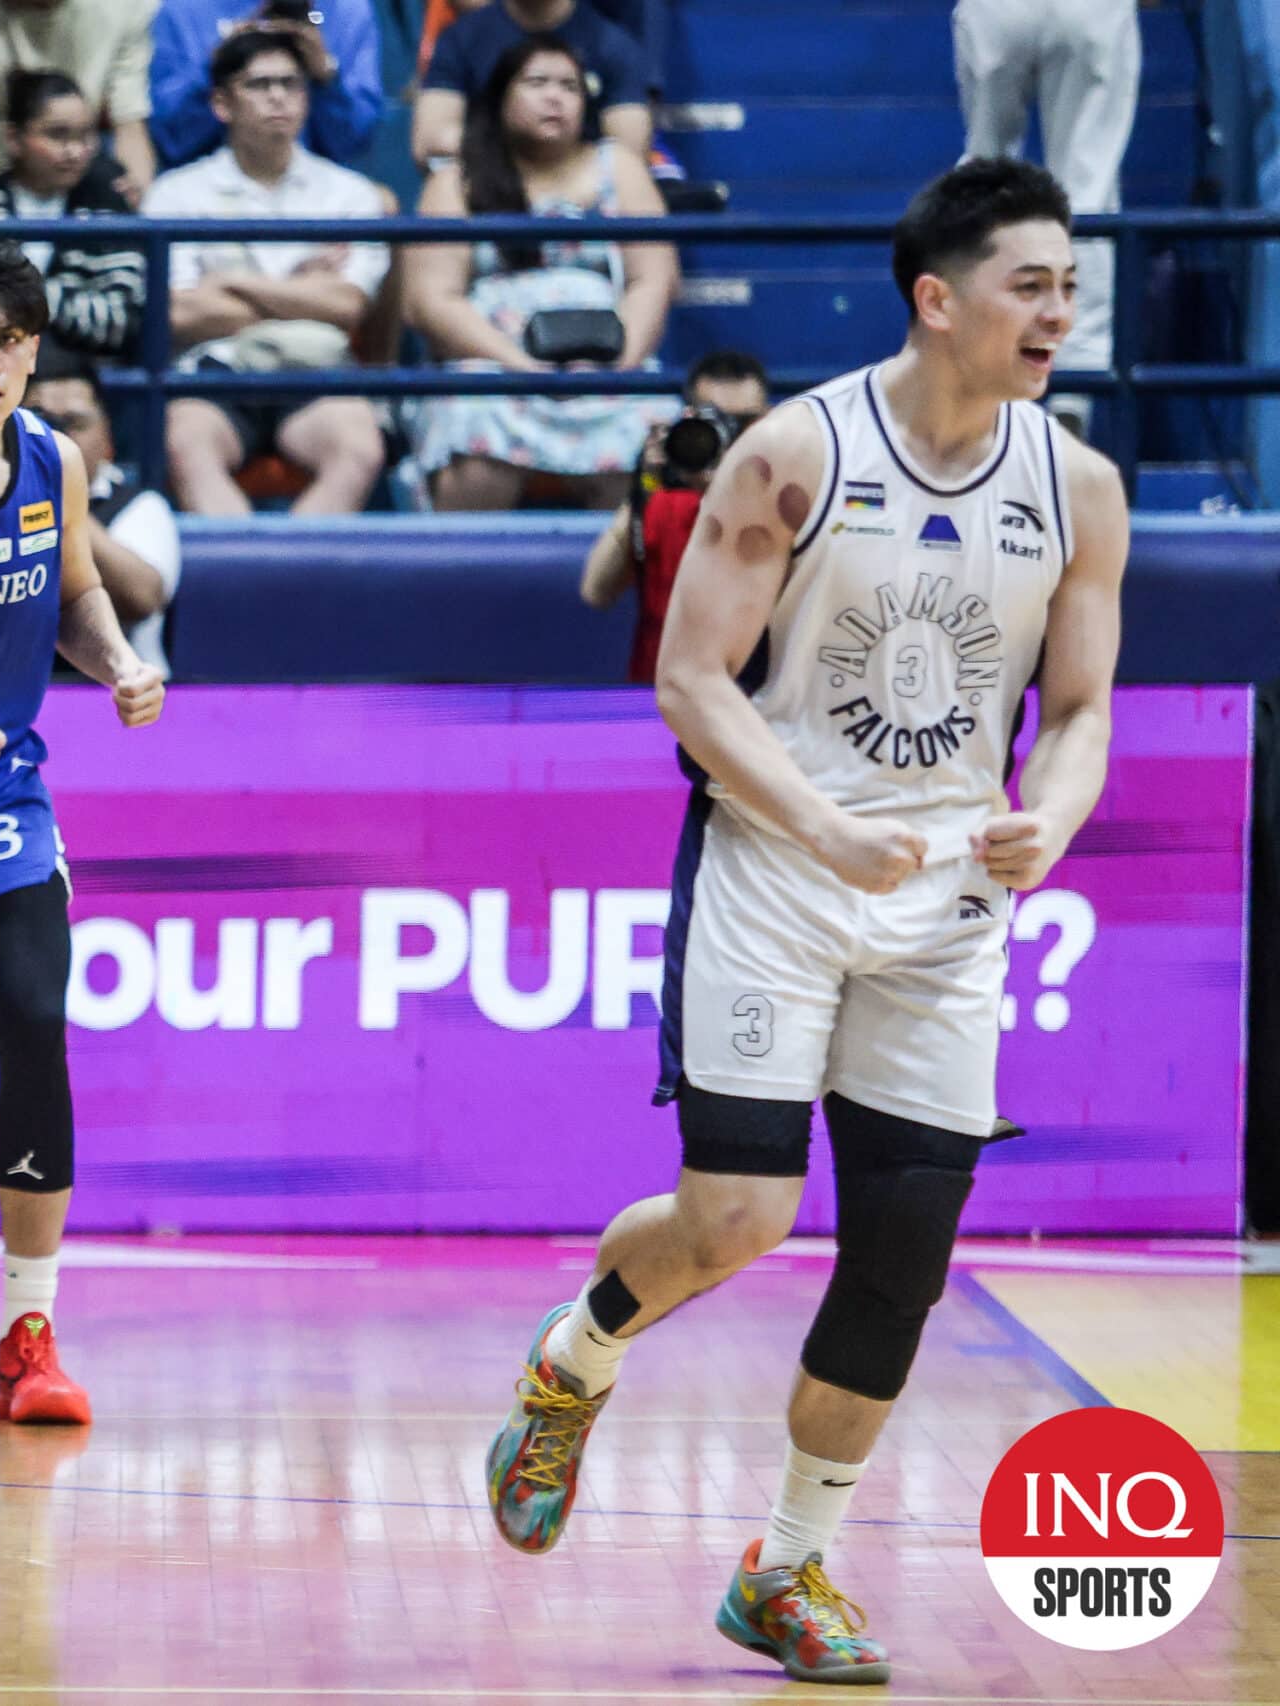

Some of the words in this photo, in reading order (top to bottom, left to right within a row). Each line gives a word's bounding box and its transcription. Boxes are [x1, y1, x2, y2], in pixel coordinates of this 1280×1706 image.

[818, 572, 1003, 691] ADAMSON
[892, 645, 928, 698] 3
[828, 696, 976, 769] FALCONS
[731, 993, 775, 1057] 3
